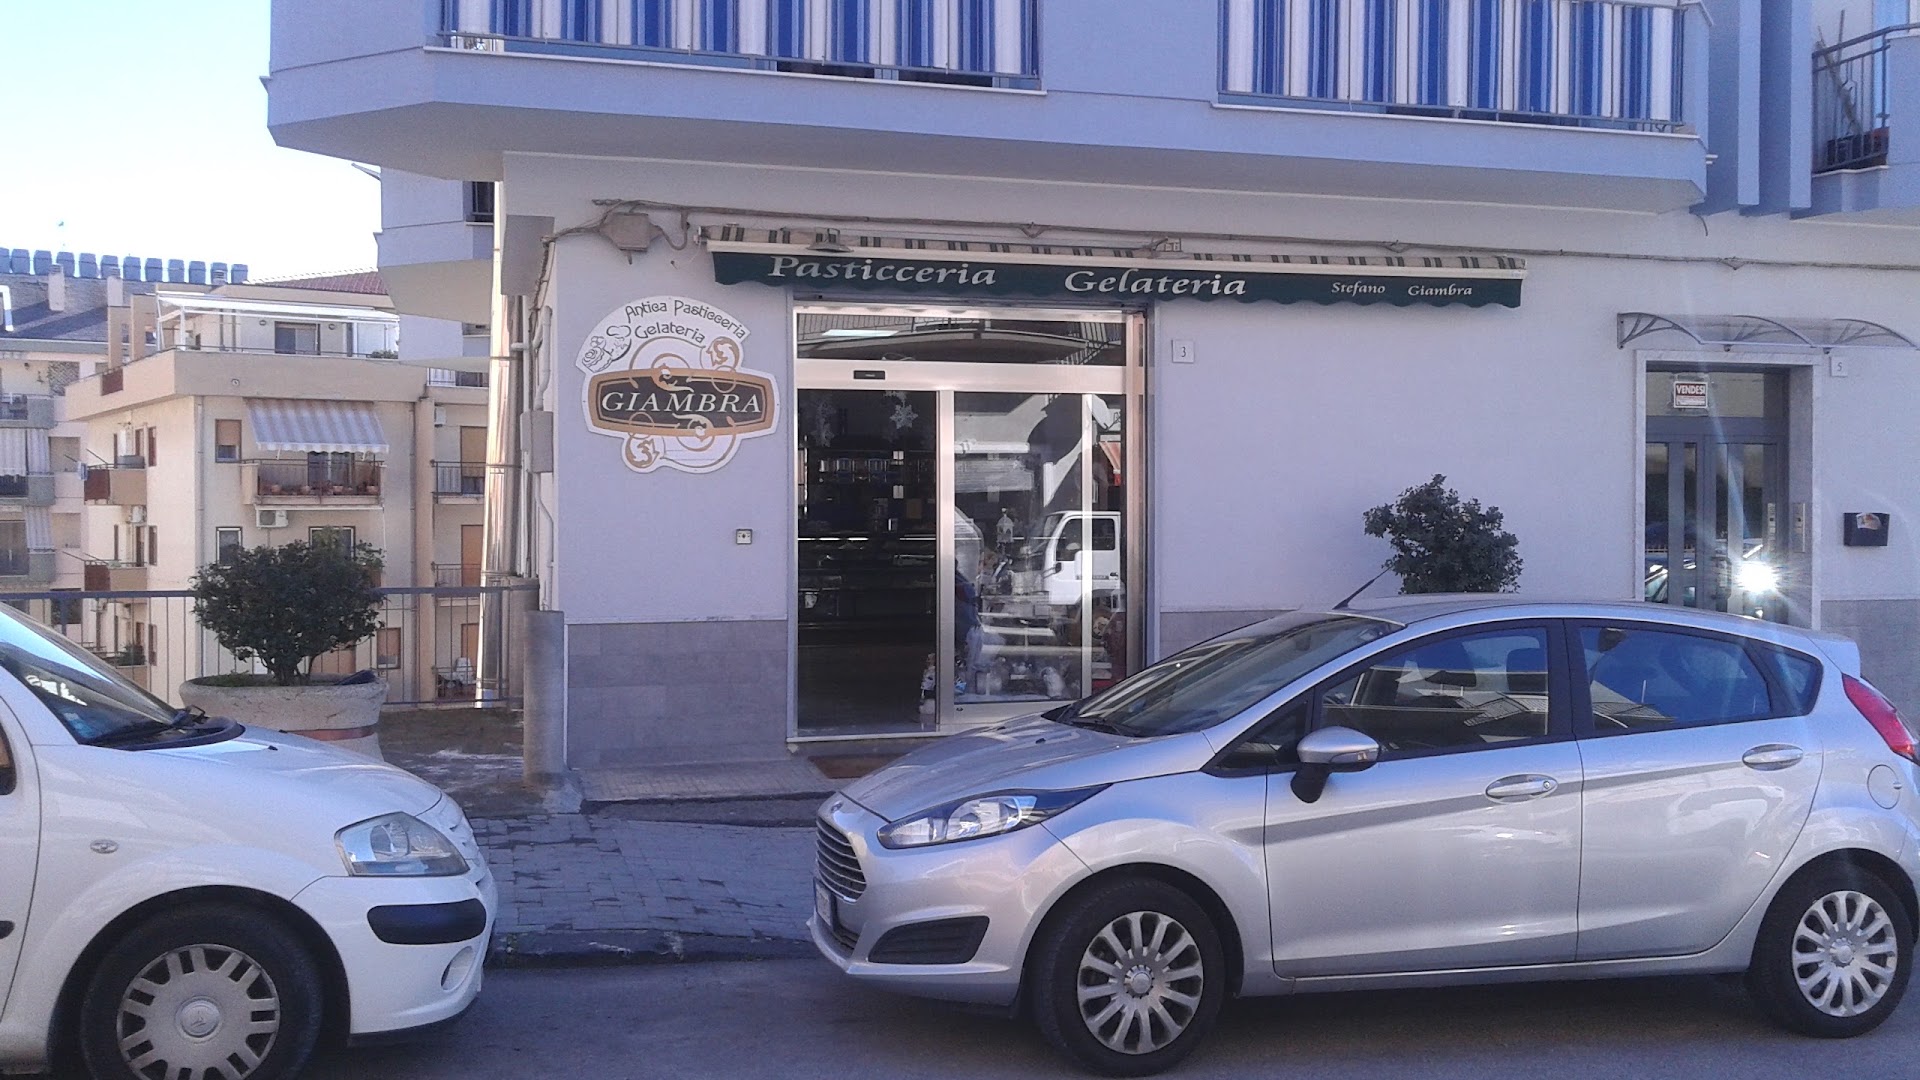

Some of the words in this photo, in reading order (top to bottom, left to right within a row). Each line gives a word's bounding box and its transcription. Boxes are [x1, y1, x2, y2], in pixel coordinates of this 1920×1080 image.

[767, 255, 997, 286] Pasticceria
[1064, 268, 1247, 296] Gelateria
[1331, 280, 1386, 297] Stefano
[1407, 283, 1473, 297] Giambra
[625, 301, 668, 324] Antica
[674, 299, 746, 339] Pasticceria
[634, 321, 706, 344] Gelateria
[1180, 346, 1187, 358] 3
[1836, 361, 1843, 372] 5
[1676, 384, 1706, 395] VENDESI
[601, 391, 762, 414] GIAMBRA
